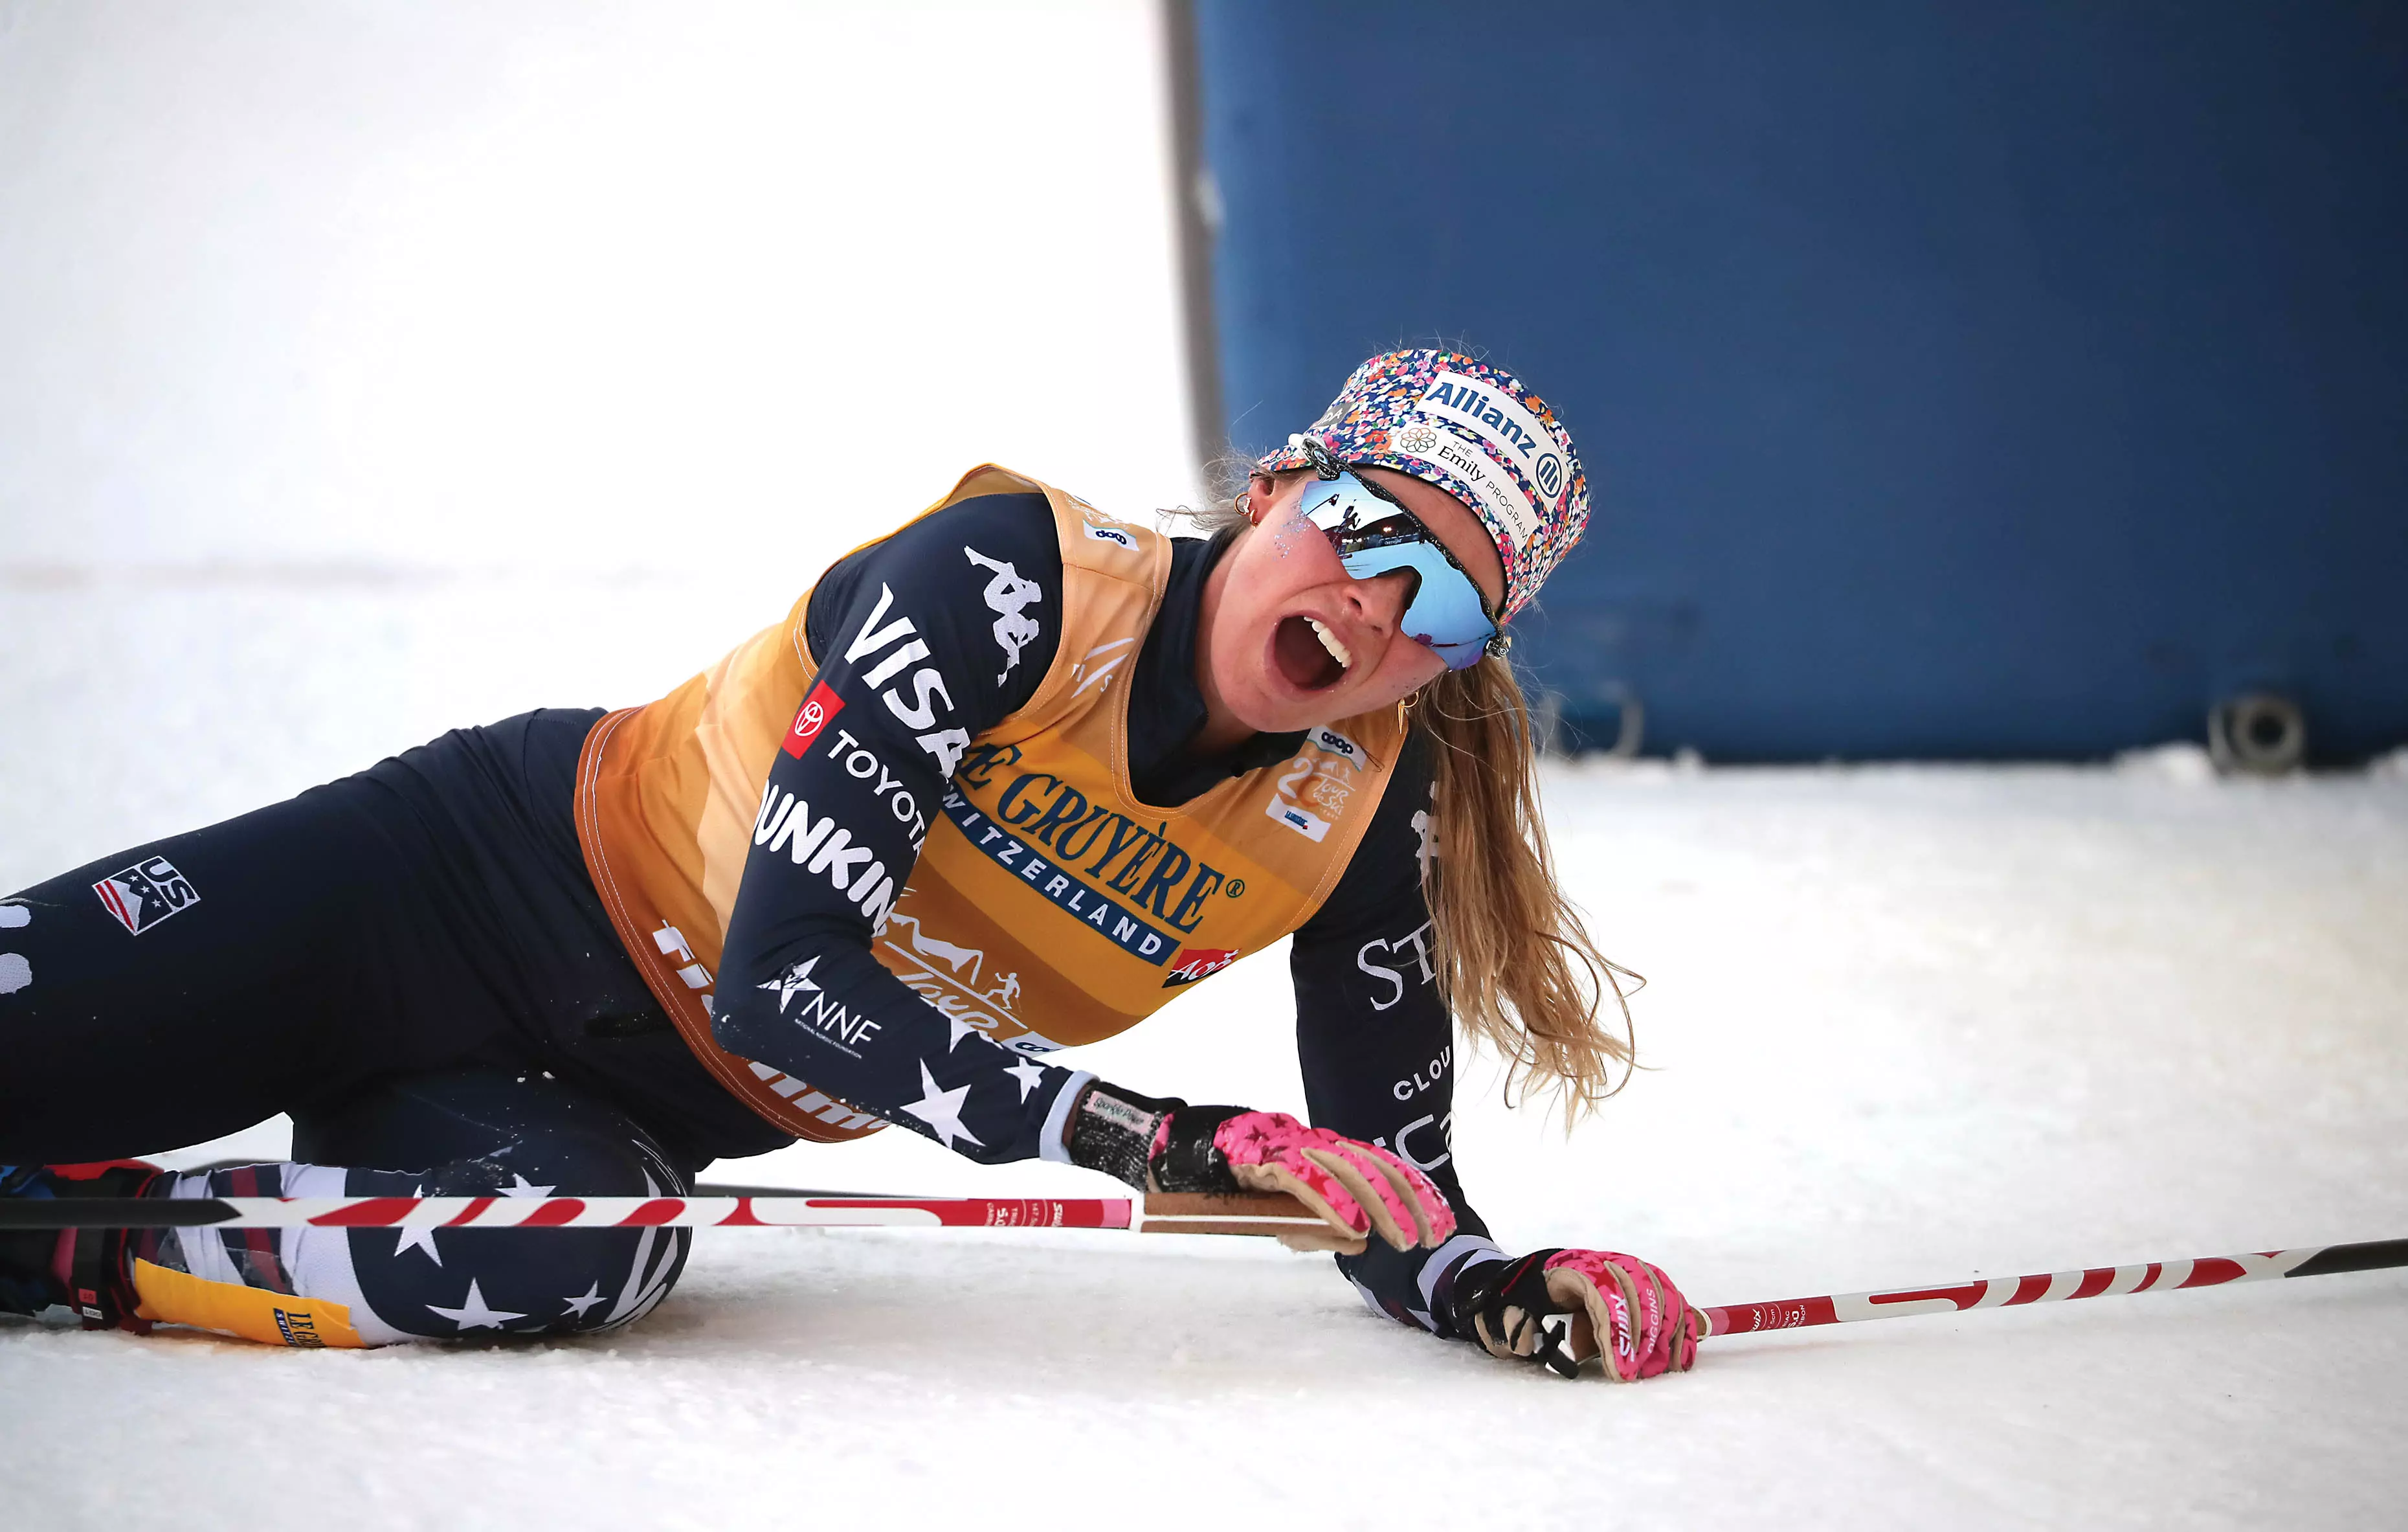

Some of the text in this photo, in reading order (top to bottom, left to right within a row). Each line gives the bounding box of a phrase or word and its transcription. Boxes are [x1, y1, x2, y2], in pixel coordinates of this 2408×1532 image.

[1425, 381, 1538, 459] Allianz
[1437, 445, 1486, 482] Emily
[1453, 440, 1473, 457] THE
[1486, 480, 1528, 542] PROGRAM
[1095, 530, 1127, 545] coop
[844, 581, 971, 782] VISA
[957, 743, 1023, 791] E
[1321, 732, 1354, 754] coop
[140, 857, 194, 909] US
[942, 785, 1163, 956] WITZERLAND
[794, 1018, 816, 1035] NATIONAL
[832, 1041, 862, 1059] FOUNDATION
[801, 991, 882, 1045] NNF
[1393, 1045, 1451, 1101] CLOU
[286, 1312, 315, 1329] LE
[1646, 1288, 1659, 1354] DIGGINS
